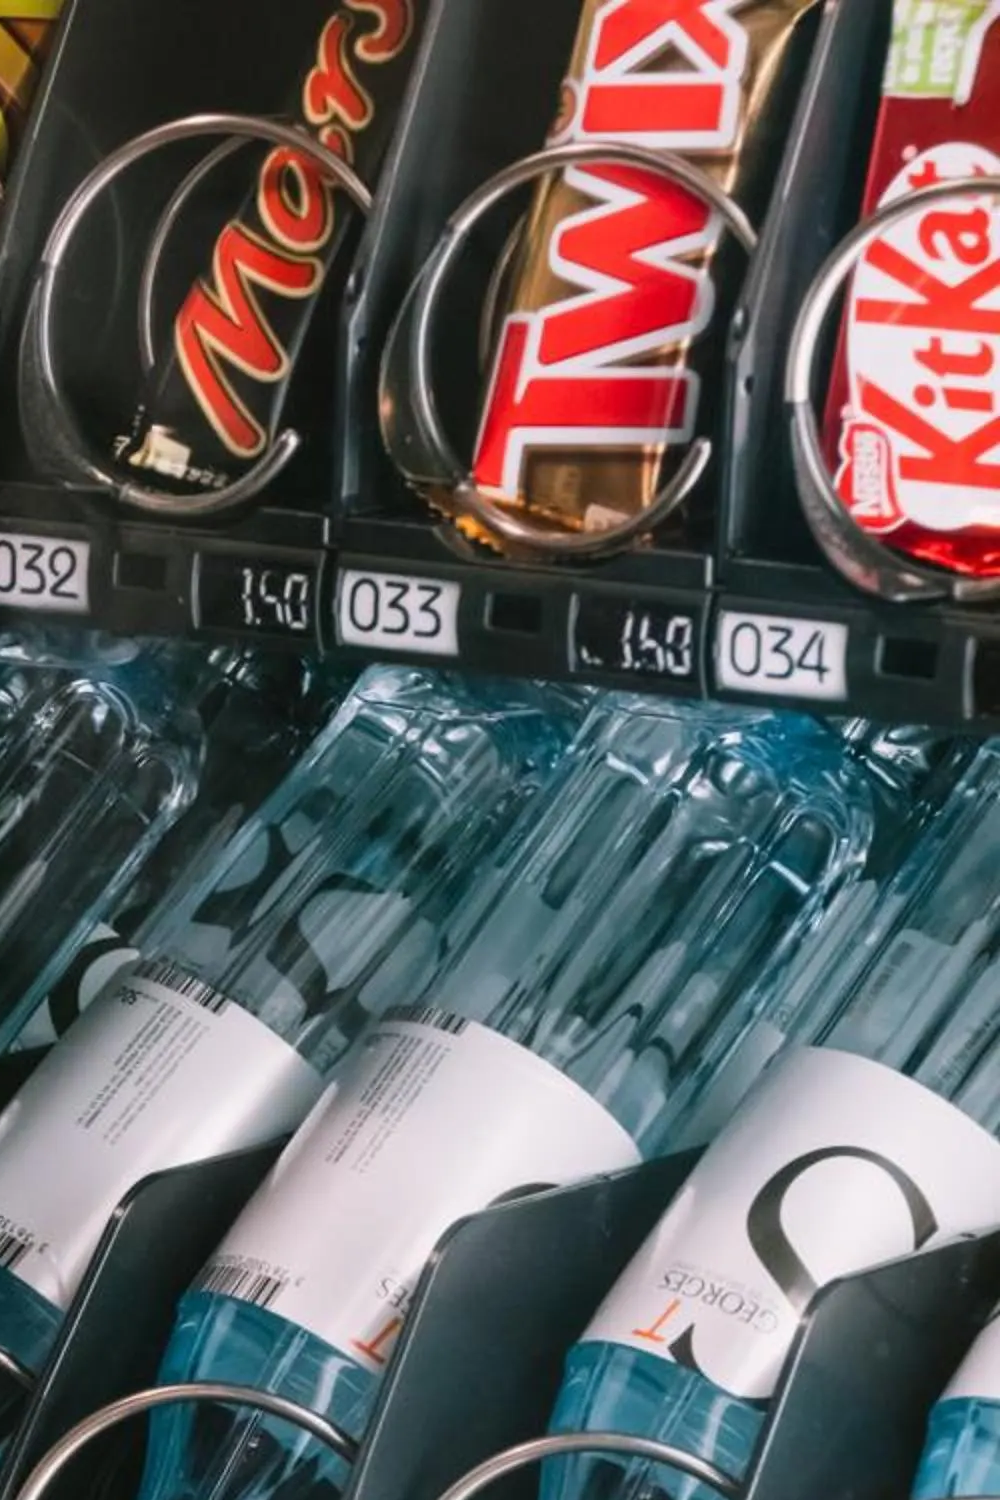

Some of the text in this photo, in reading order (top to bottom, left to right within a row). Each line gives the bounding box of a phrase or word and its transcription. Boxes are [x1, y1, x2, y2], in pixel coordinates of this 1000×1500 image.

[473, 0, 747, 497] TWIX
[348, 577, 443, 639] 033
[728, 620, 832, 679] 034
[657, 1268, 781, 1336] GEORGES
